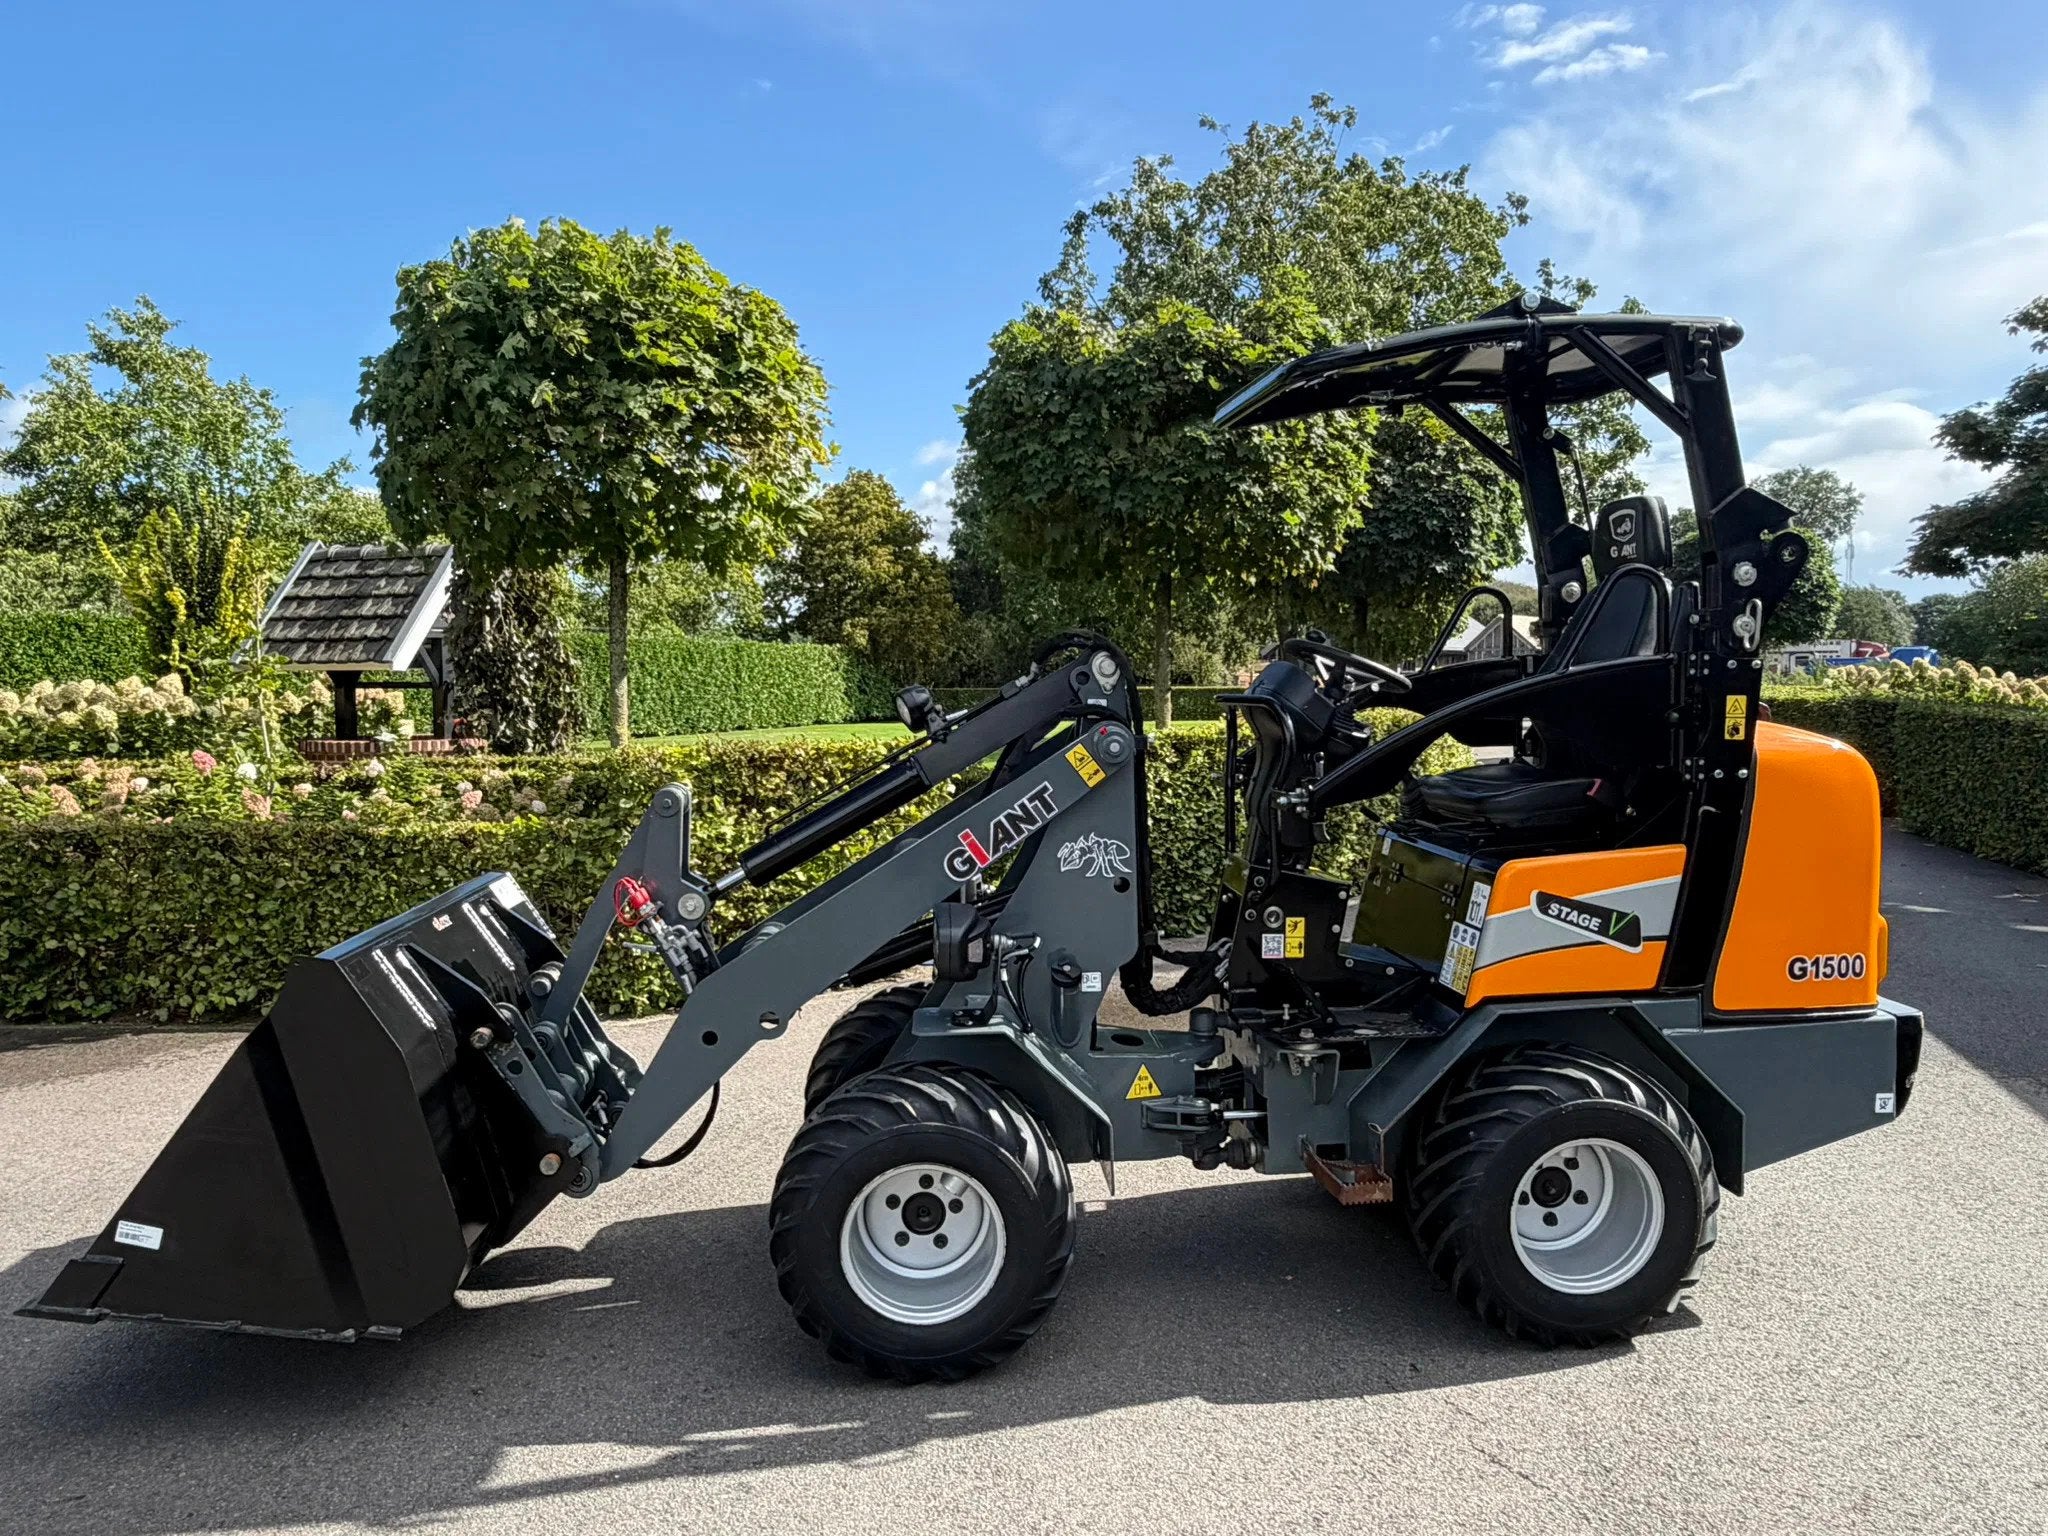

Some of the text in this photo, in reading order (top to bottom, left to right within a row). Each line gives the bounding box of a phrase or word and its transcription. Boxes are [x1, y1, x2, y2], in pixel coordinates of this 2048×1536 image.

[1610, 543, 1637, 558] GANT
[1547, 902, 1634, 937] STAGE V
[1786, 953, 1866, 982] G1500
